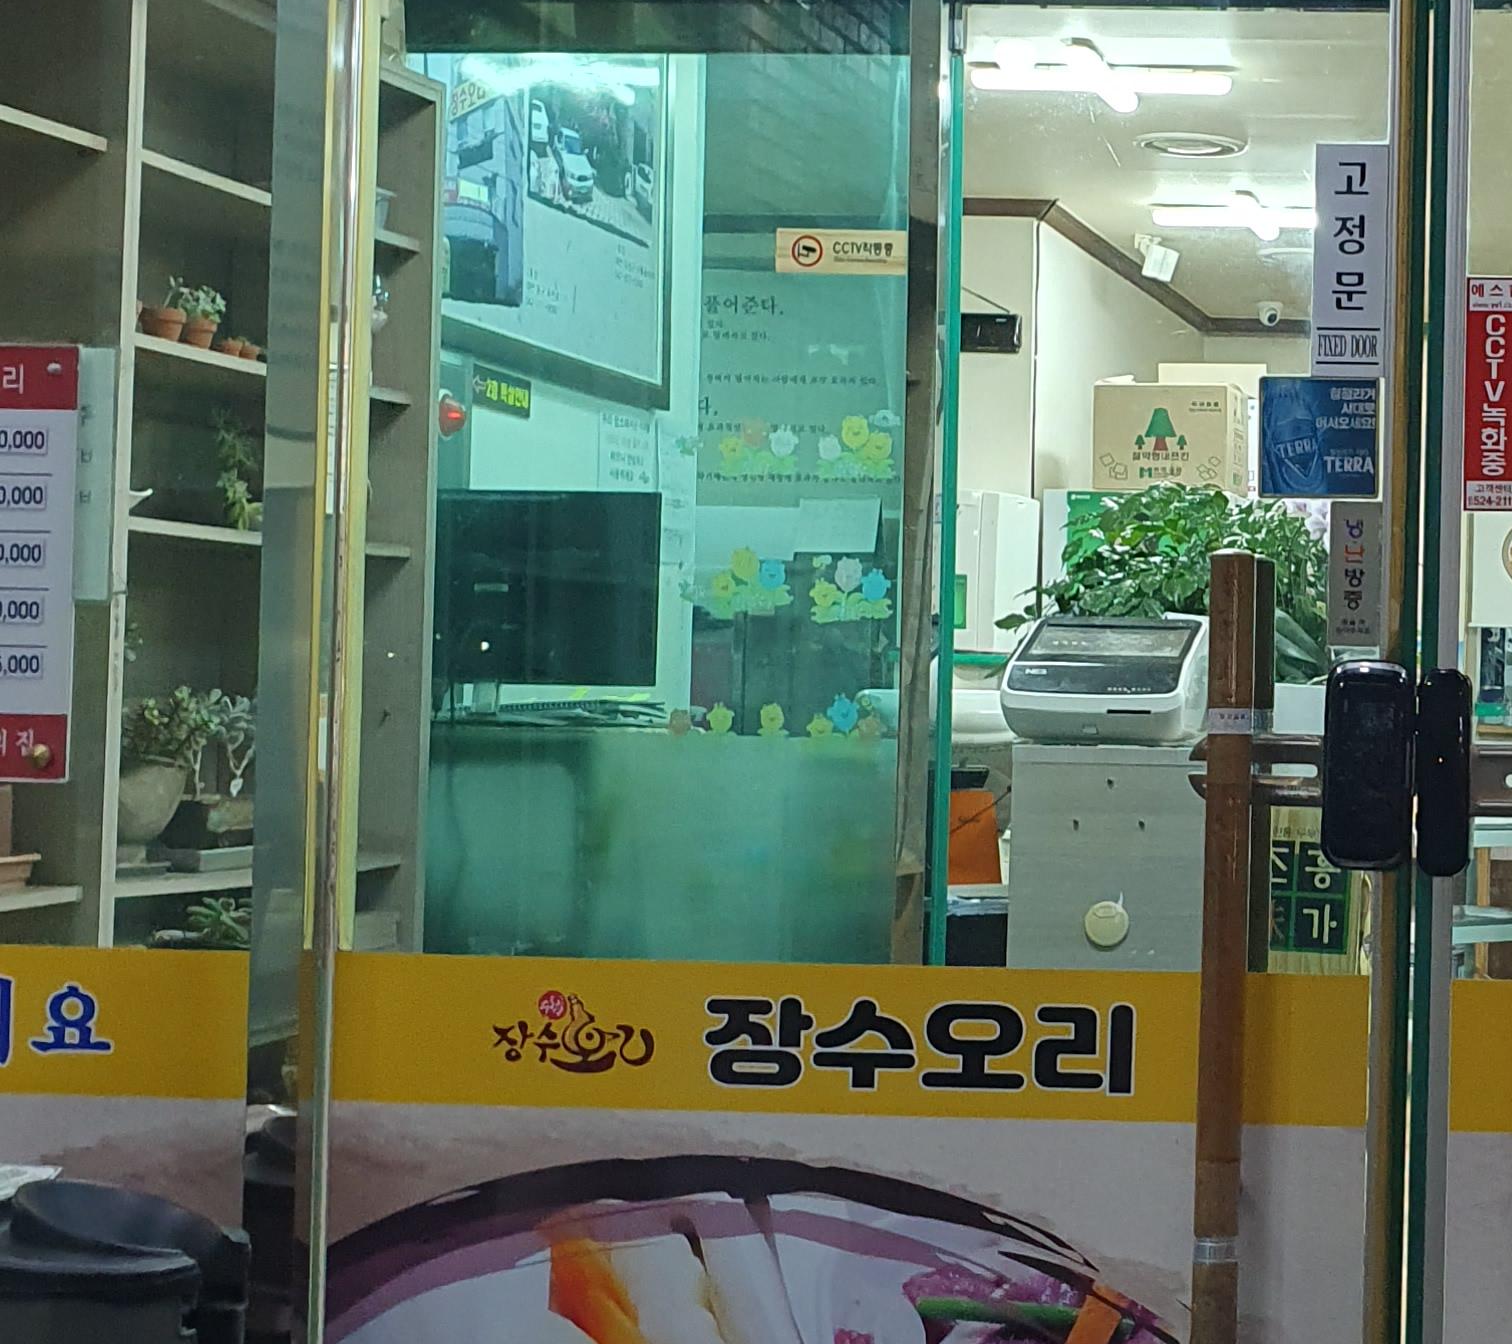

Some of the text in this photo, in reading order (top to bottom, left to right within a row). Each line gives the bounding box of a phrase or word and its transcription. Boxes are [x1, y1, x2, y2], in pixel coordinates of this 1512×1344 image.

[1331, 160, 1370, 312] 고정문
[1317, 332, 1378, 358] FIXED DOOR
[1480, 314, 1507, 477] CCTV녹화중
[1323, 456, 1375, 474] TERRA
[0, 976, 112, 1064] 요
[703, 993, 1137, 1098] 장수오리
